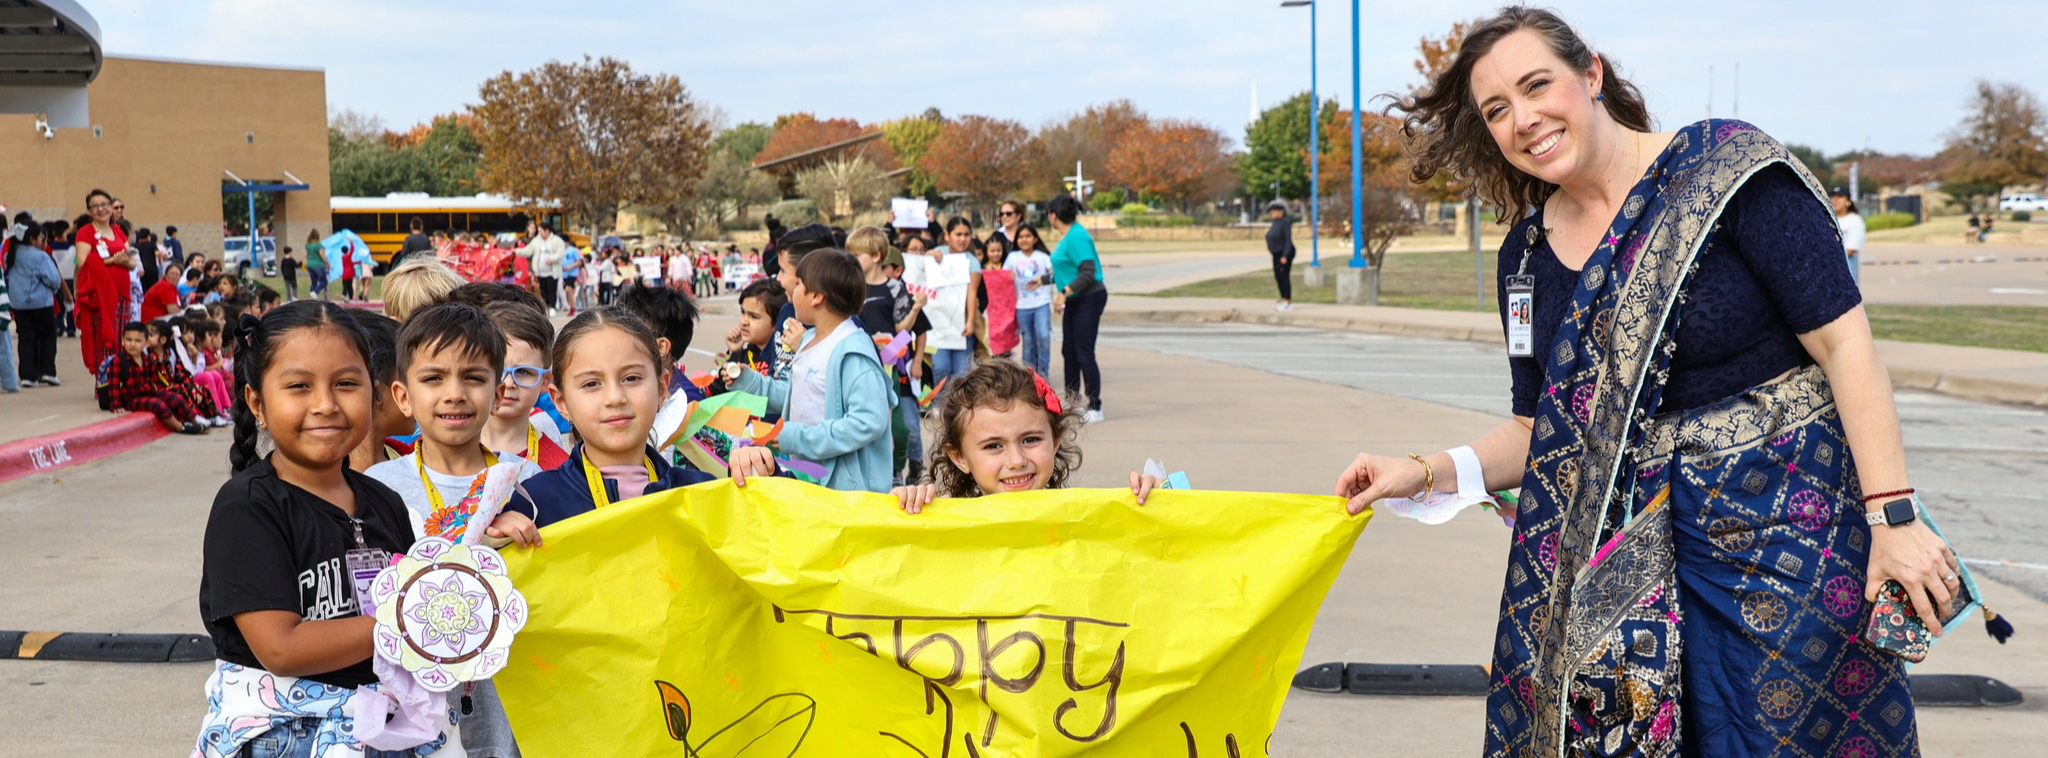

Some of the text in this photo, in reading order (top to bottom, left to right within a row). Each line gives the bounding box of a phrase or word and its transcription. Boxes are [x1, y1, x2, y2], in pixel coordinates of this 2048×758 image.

[904, 281, 938, 300] RALTA
[29, 440, 72, 469] FIRE LANE
[298, 557, 358, 622] CAL
[772, 602, 1129, 747] ppy
